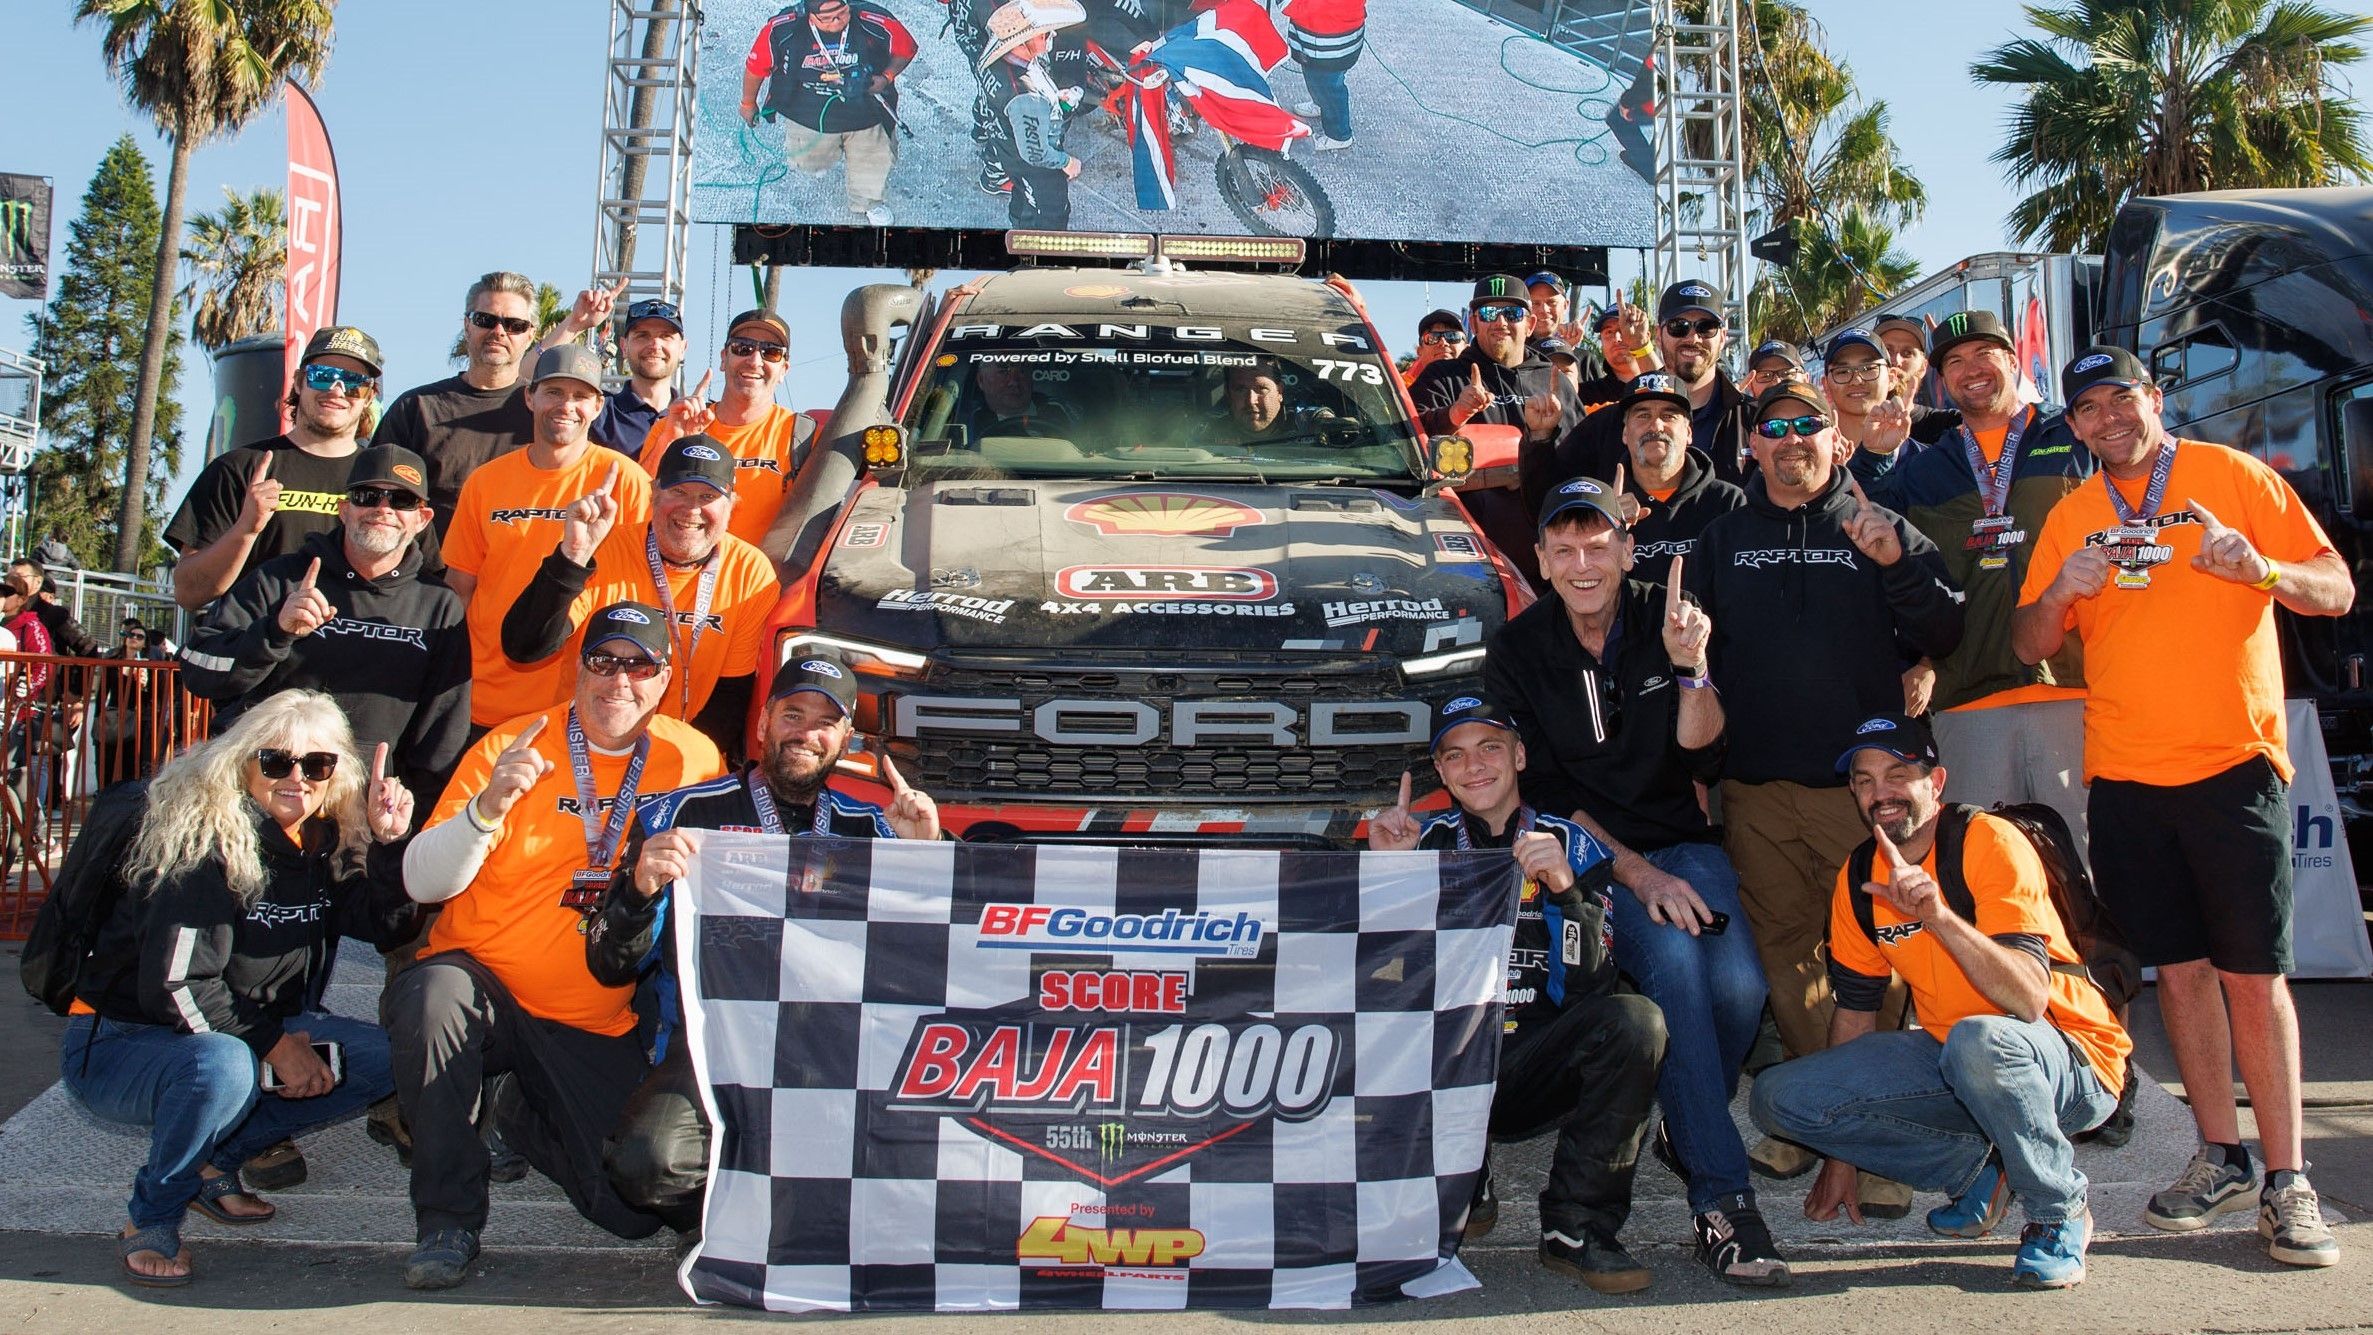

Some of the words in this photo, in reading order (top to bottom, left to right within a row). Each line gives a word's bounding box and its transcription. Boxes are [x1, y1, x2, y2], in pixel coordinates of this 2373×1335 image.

[951, 323, 1369, 350] RANGER
[969, 352, 1051, 364] Powered
[1055, 352, 1078, 365] by
[1081, 352, 1129, 364] Shell
[1133, 353, 1200, 365] Biofuel
[1203, 354, 1257, 367] Blend
[1031, 369, 1071, 382] CARO
[1311, 358, 1384, 386] 773
[1638, 374, 1669, 392] FOX
[734, 458, 783, 475] TOR
[1994, 431, 2021, 489] FINISHER
[2146, 441, 2176, 503] FINISHER
[490, 508, 567, 527] RAPTO
[1997, 530, 2026, 545] 1000
[1733, 548, 1859, 571] RAPTOR
[2137, 545, 2171, 561] 1000
[1081, 570, 1256, 593] ARB
[691, 571, 715, 640] FINISHER
[881, 588, 1016, 615] Herrod
[907, 602, 1007, 624] PERFORMANCE
[1112, 602, 1296, 617] ACCESSORIES
[1321, 597, 1444, 619] Herrod
[1360, 610, 1450, 623] PERFORMANCE
[312, 617, 428, 652] APTOR
[1446, 698, 1478, 713] Ford
[895, 694, 1433, 746] FORD
[609, 756, 645, 832] FINISHER
[754, 785, 783, 834] FINISH
[2295, 852, 2332, 869] Tires
[979, 903, 1264, 943] BFGoodrich
[1874, 920, 1923, 947] RAP
[1227, 943, 1256, 957] Tires
[1039, 970, 1187, 1014] SCORE
[897, 1022, 1120, 1103] BAJA
[1138, 1022, 1336, 1109] 1000
[1045, 1124, 1093, 1149] 55th
[1126, 1132, 1189, 1143] MONSTER
[1070, 1203, 1137, 1215] Presented
[1139, 1203, 1156, 1217] by
[1016, 1216, 1206, 1266] 4WP
